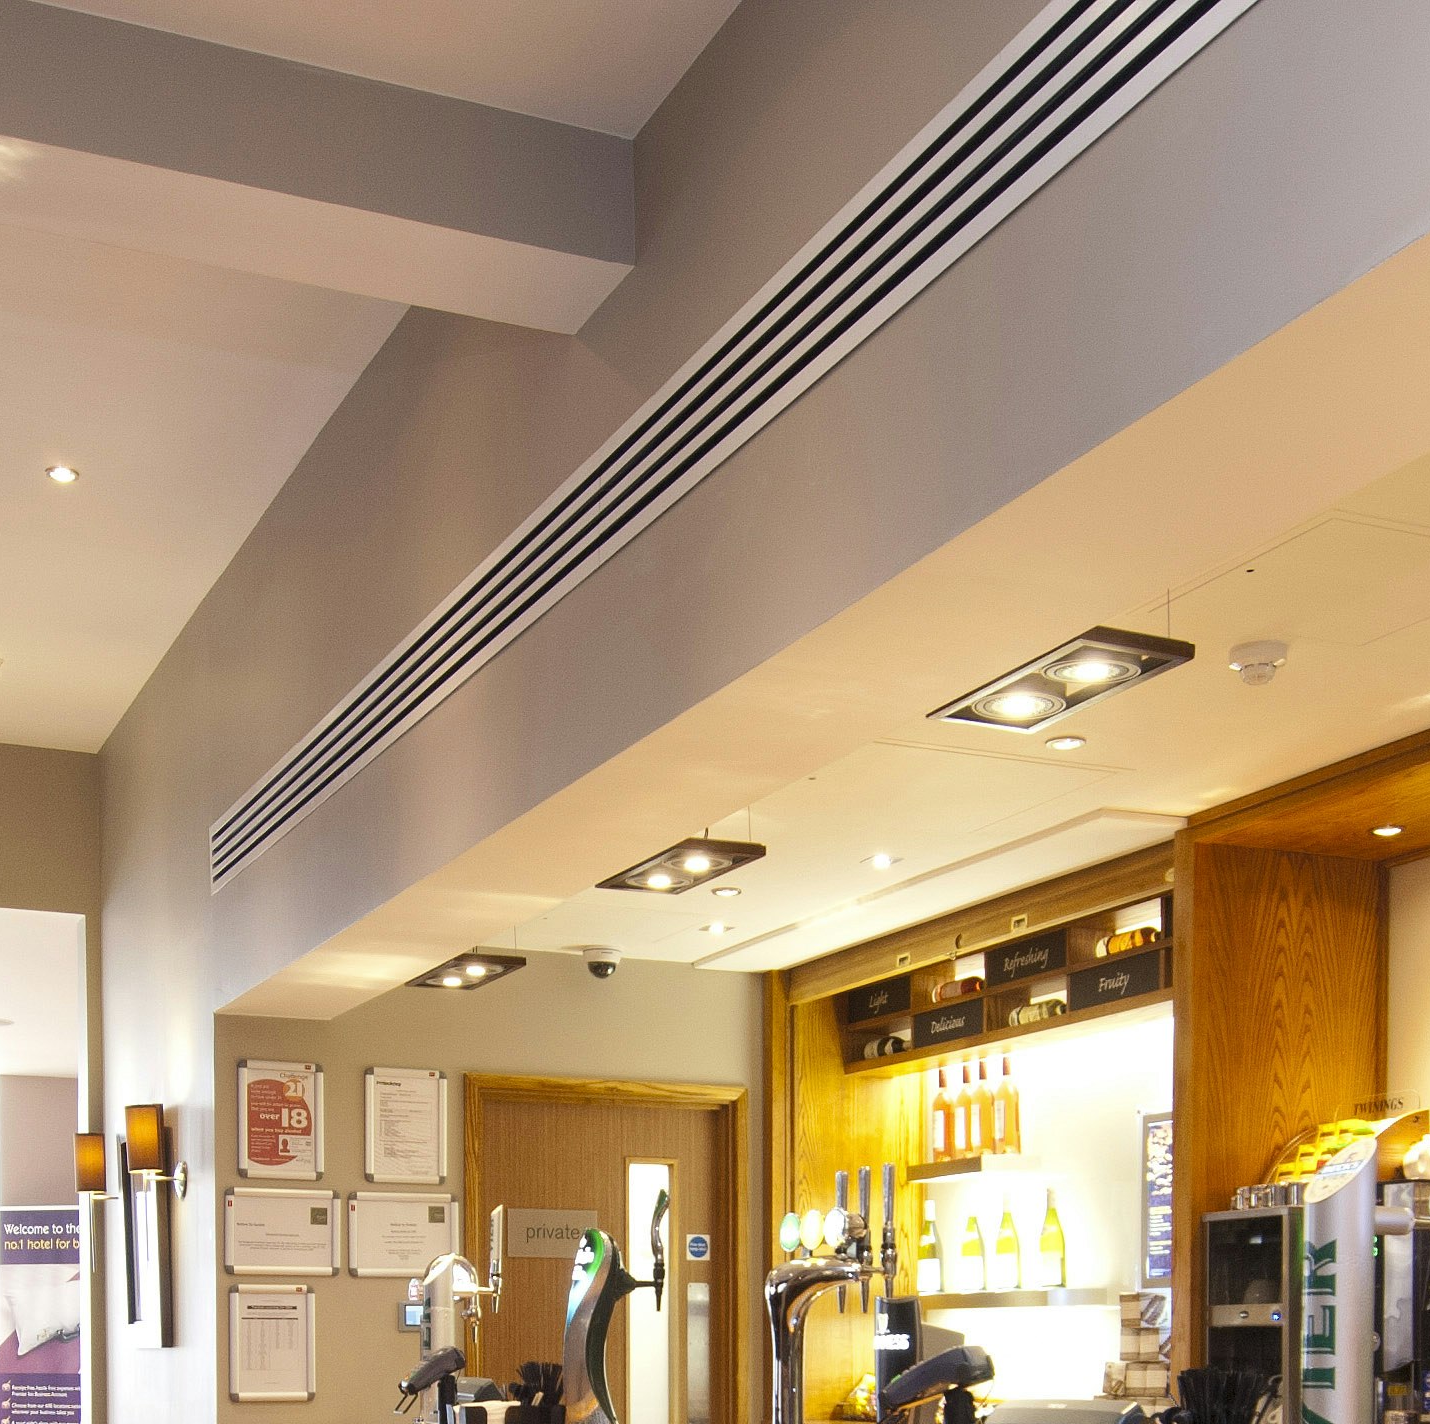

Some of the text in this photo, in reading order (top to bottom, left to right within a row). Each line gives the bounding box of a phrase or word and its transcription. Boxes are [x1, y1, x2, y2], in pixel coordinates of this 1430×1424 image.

[1003, 947, 1049, 978] Refreshing
[1098, 972, 1129, 995] Fruity
[869, 990, 889, 1015] Light
[931, 1016, 965, 1034] Delicious
[284, 1082, 303, 1097] 21
[1354, 1097, 1404, 1116] TWININGS
[281, 1108, 308, 1129] 18
[4, 1223, 49, 1235] Welcome
[52, 1223, 63, 1234] to
[526, 1224, 580, 1243] private
[4, 1239, 23, 1250] no.1
[27, 1238, 53, 1250] hotel
[56, 1238, 70, 1250] for
